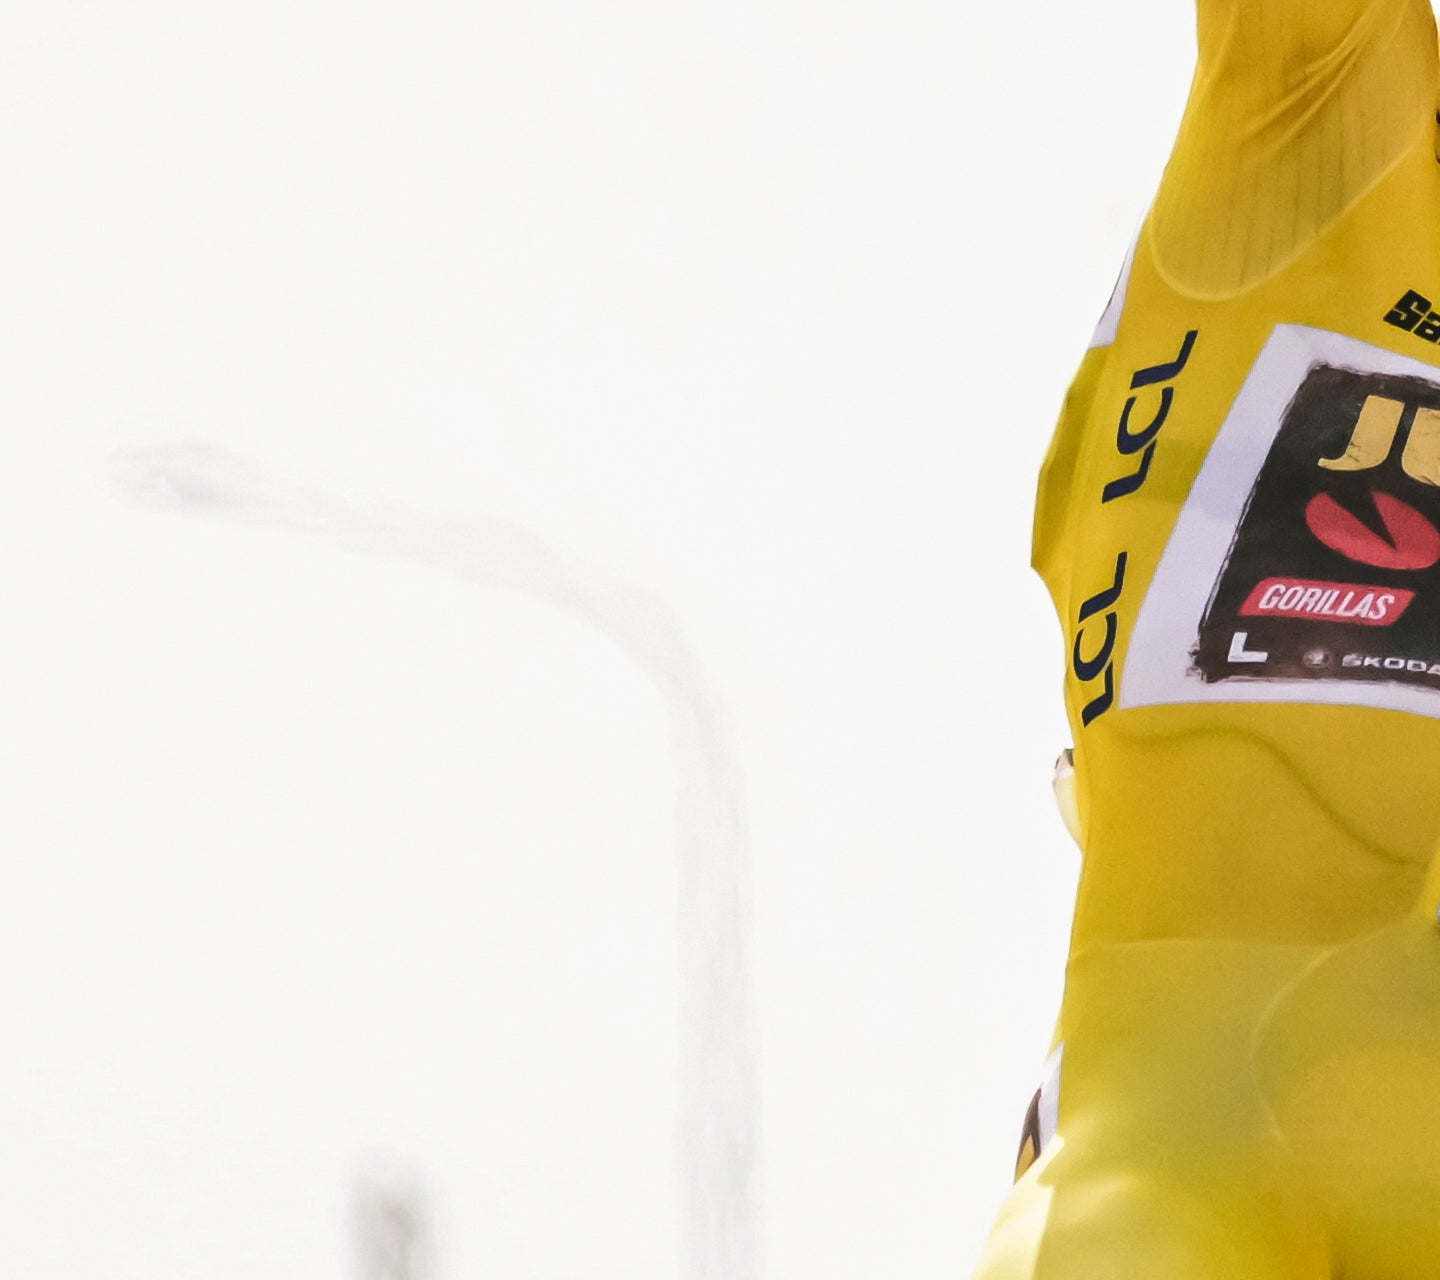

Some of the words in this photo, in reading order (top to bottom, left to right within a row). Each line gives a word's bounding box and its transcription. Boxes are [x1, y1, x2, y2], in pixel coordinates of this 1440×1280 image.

[1101, 329, 1199, 504] LCL
[1073, 551, 1128, 728] LCL
[1258, 584, 1395, 620] GORILLAS
